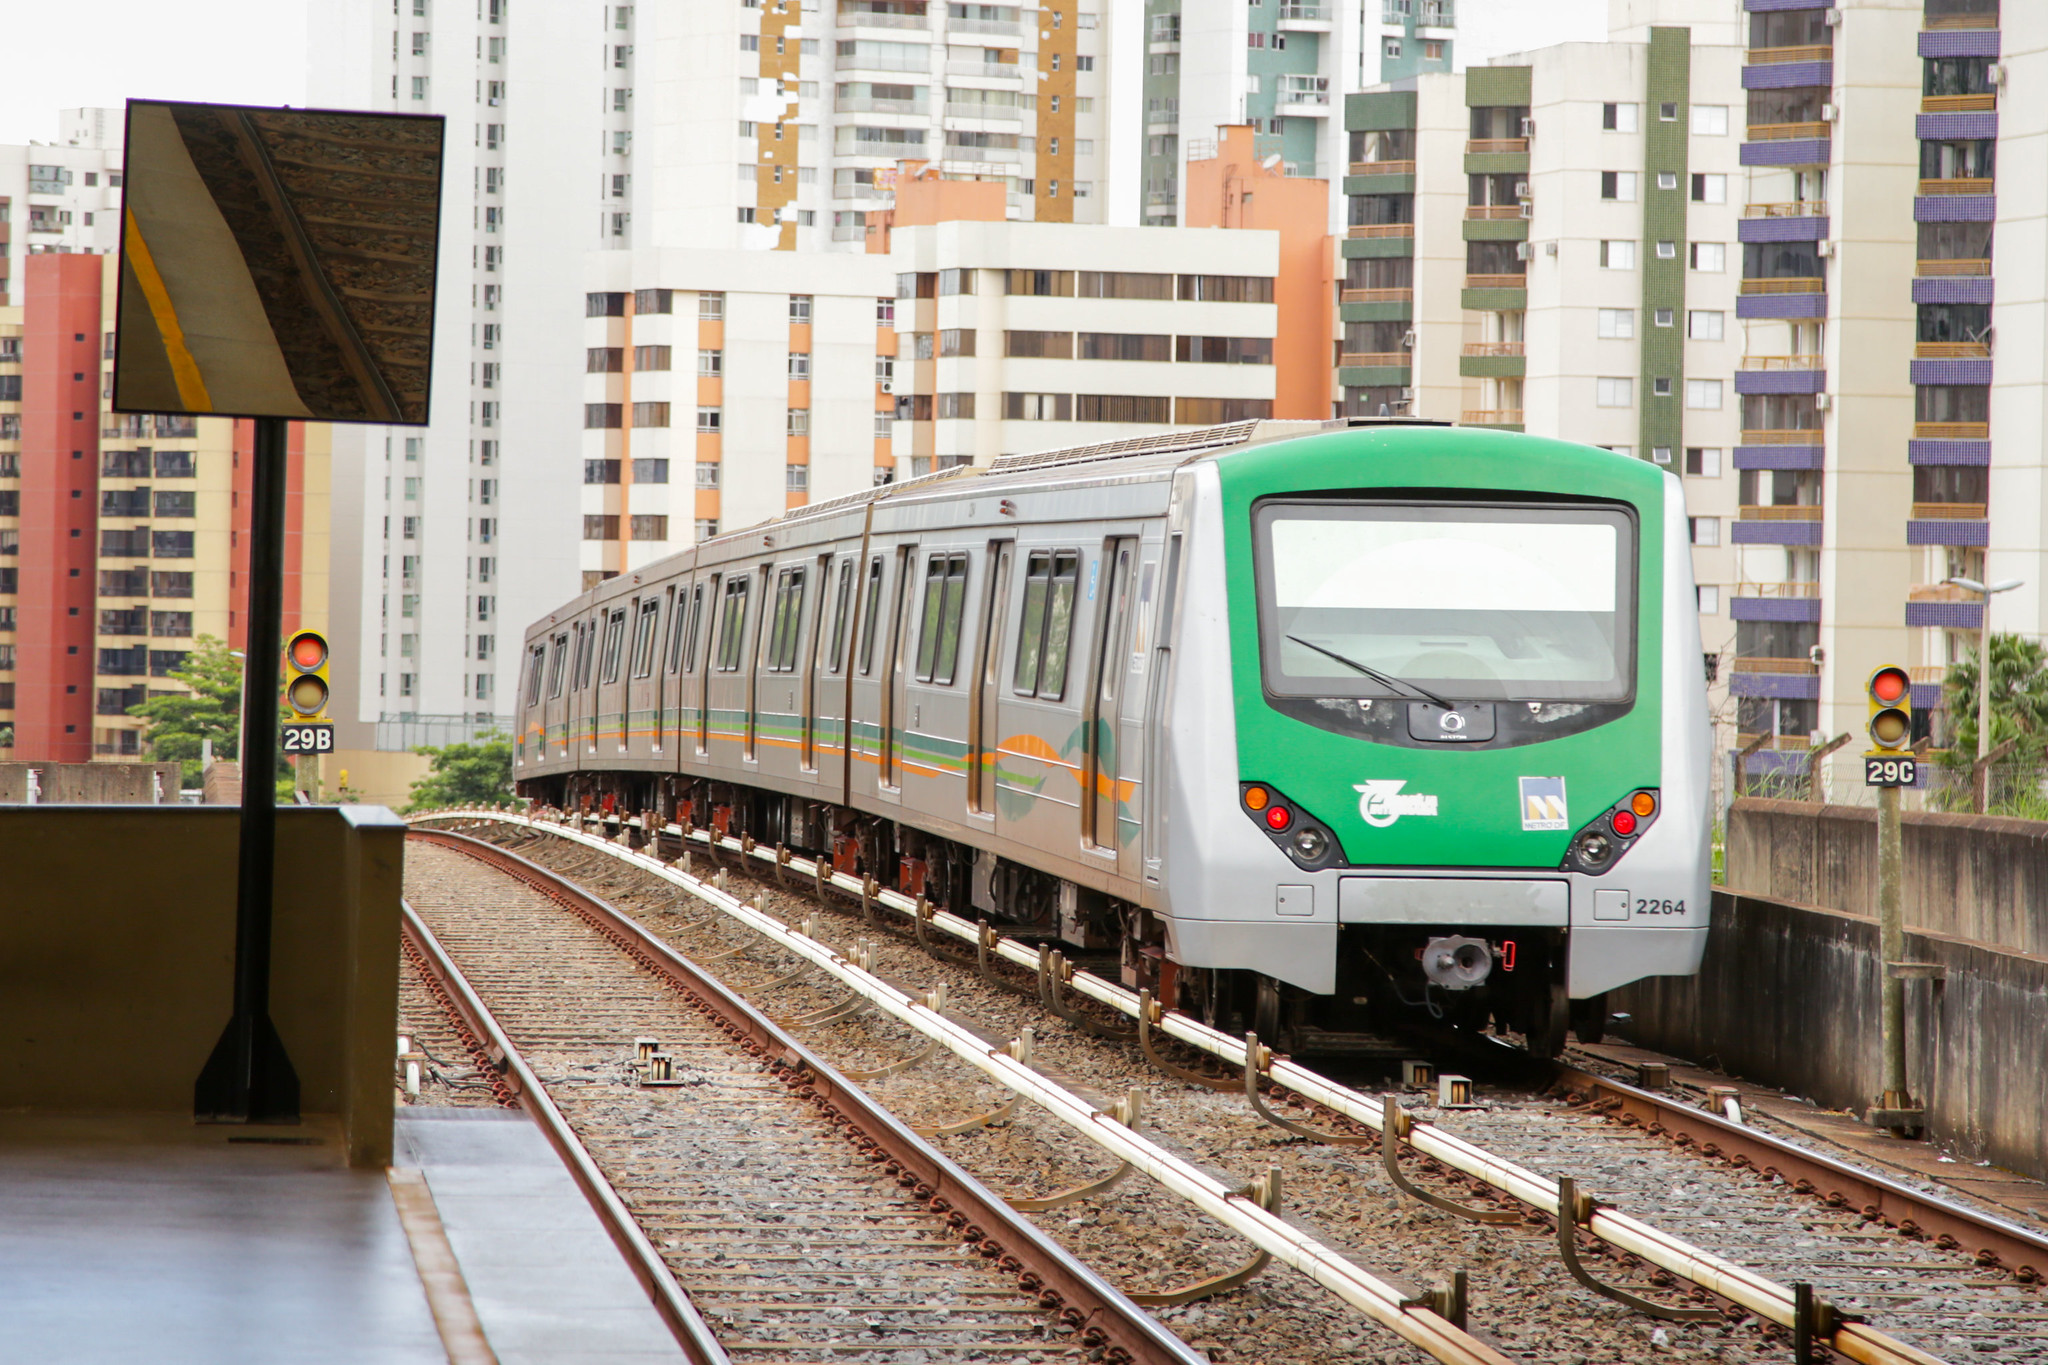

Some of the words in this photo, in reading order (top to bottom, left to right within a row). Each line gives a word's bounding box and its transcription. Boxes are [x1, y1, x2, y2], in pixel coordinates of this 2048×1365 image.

[284, 728, 331, 750] 29B
[1868, 760, 1914, 783] 29C
[1636, 898, 1686, 915] 2264
